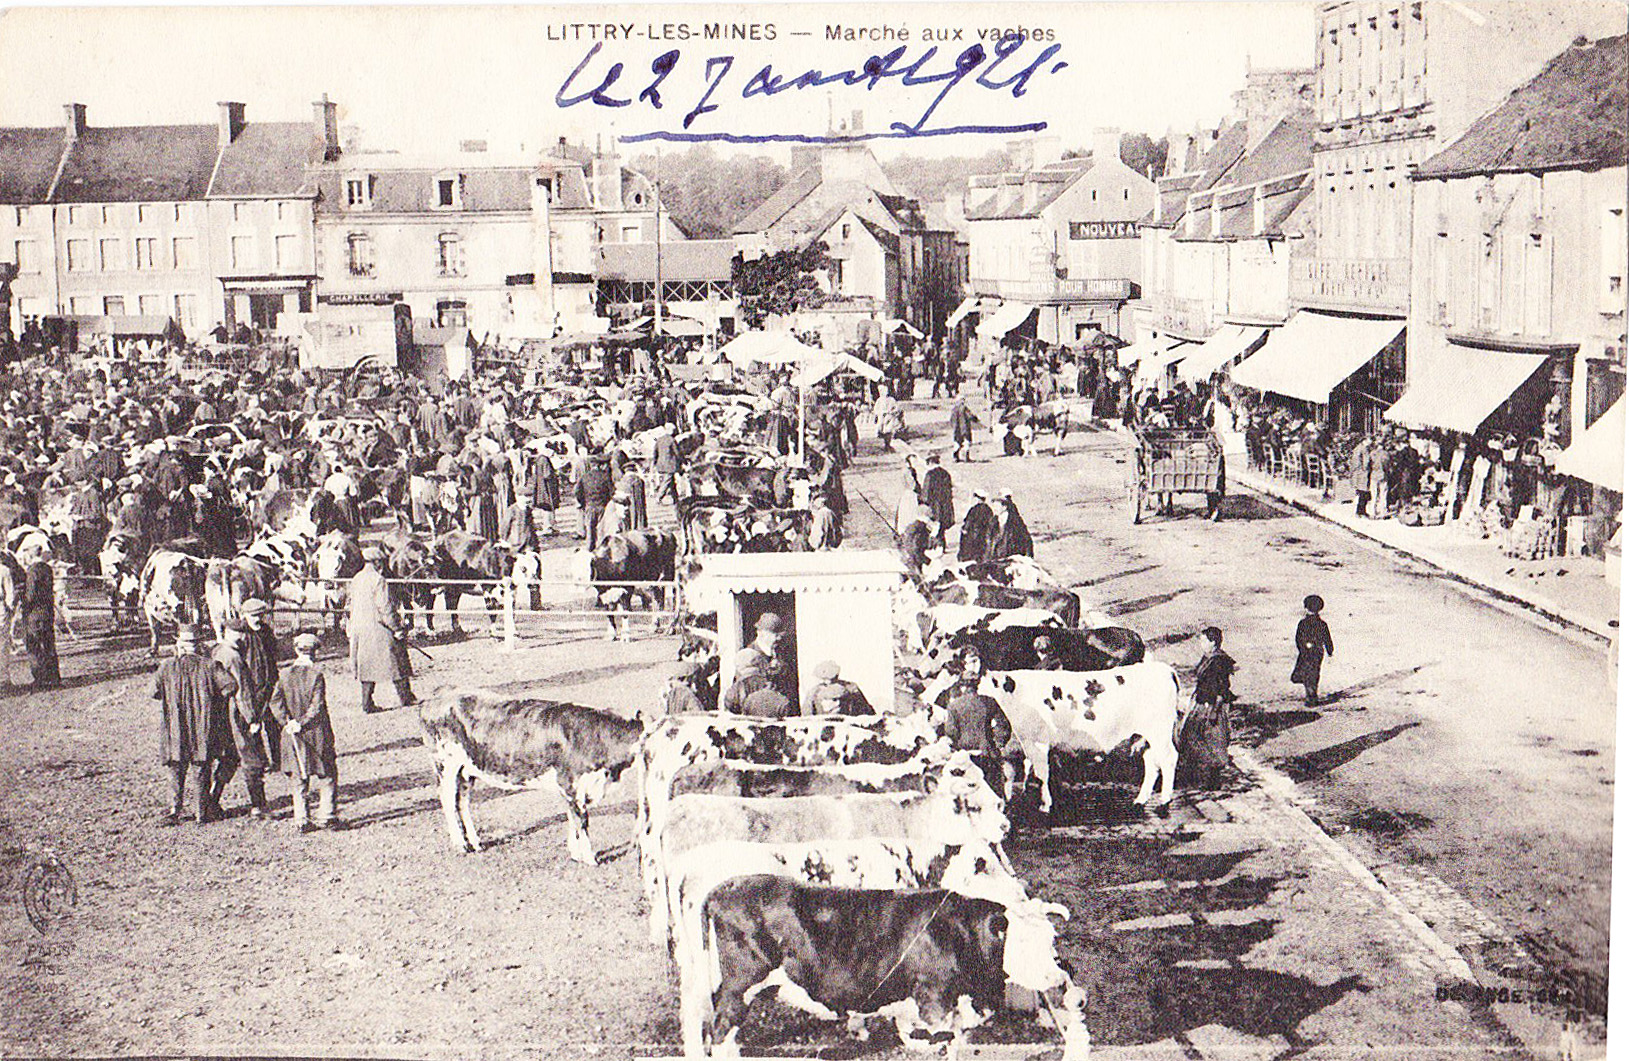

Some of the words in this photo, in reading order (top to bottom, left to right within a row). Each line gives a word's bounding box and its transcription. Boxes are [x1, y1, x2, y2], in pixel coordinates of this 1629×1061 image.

[1060, 280, 1083, 294] POUR
[1087, 280, 1124, 294] HOMMES
[329, 293, 391, 303] CHAPELLERIE
